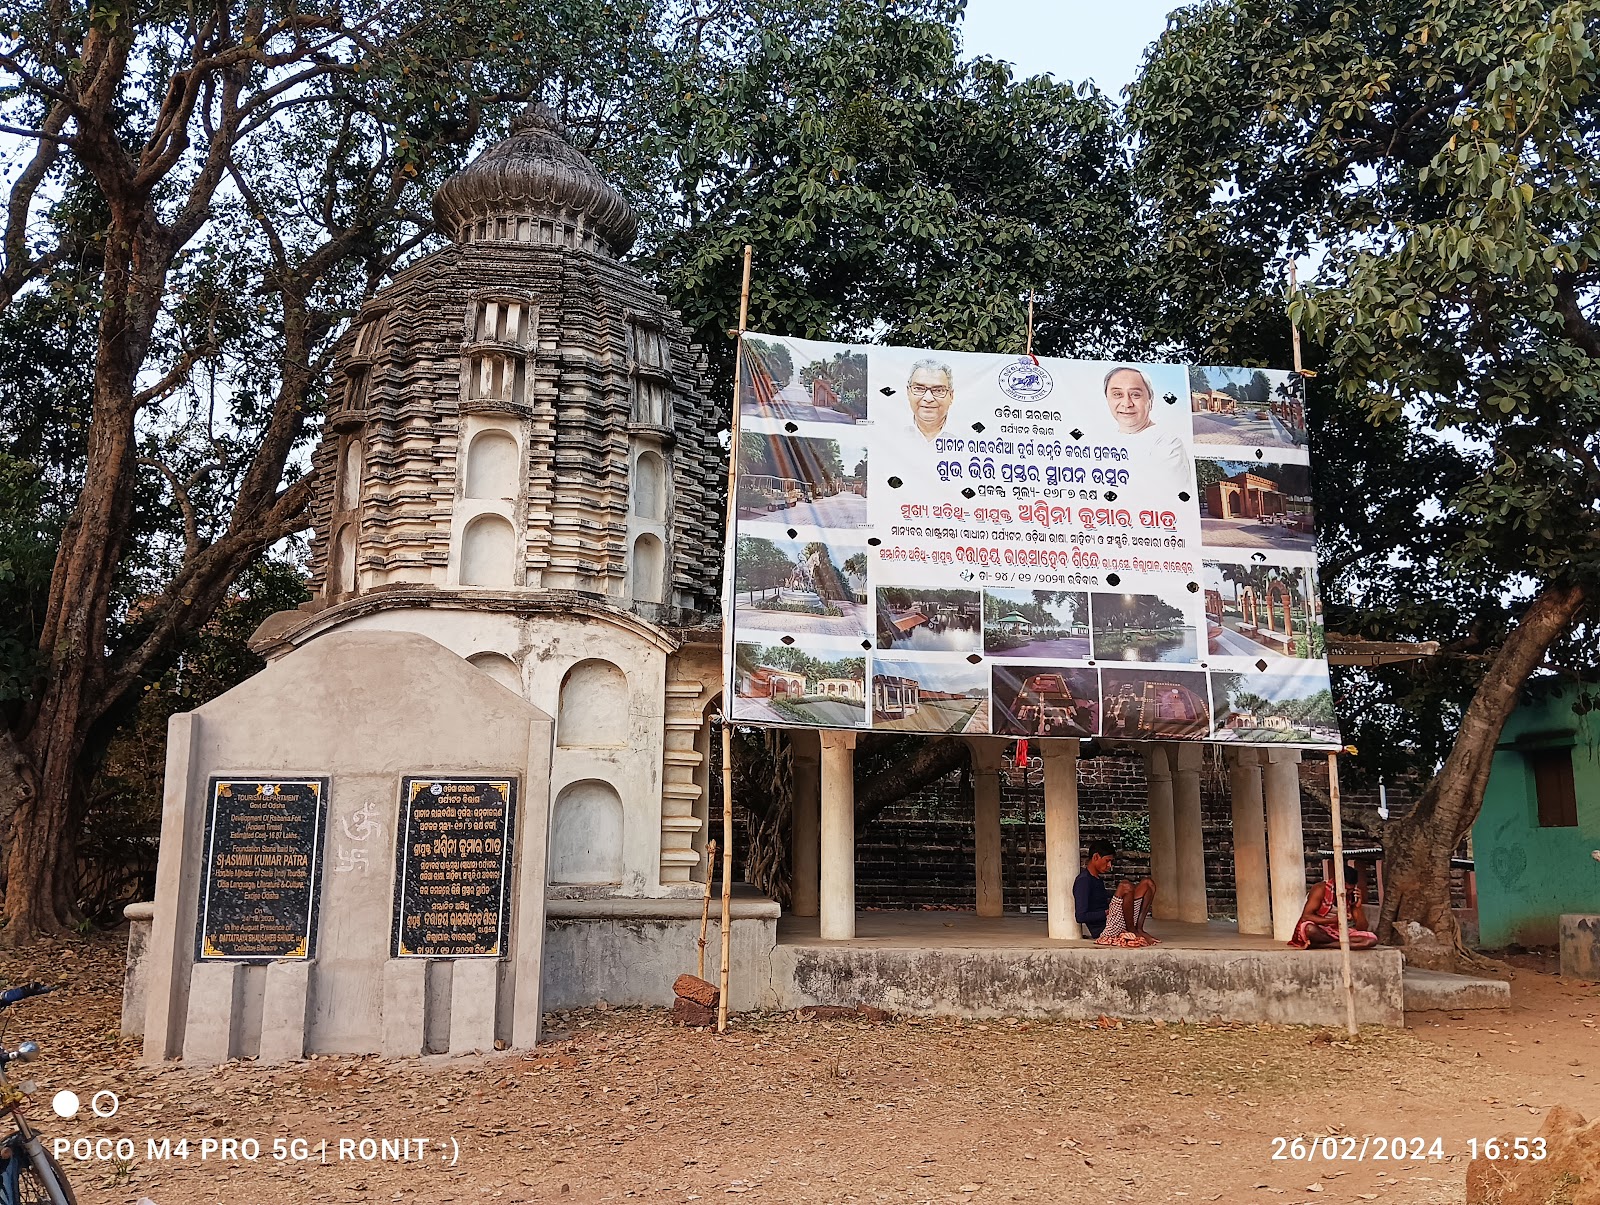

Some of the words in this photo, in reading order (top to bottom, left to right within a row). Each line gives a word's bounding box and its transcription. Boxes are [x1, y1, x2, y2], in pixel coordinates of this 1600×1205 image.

[1026, 410, 1062, 421] ସରକାର
[1001, 423, 1030, 434] ପର୍ଯ୍ୟଟନ
[1032, 425, 1054, 435] ବିଭାଗ
[936, 438, 964, 453] ପ୍ରାଚୀନ
[968, 437, 1014, 454] ରାଇବଣିଆ
[1018, 439, 1034, 459] ଦୁର୍ଗ
[1037, 440, 1061, 460] ଉନ୍ନତି
[1065, 445, 1090, 459] କରଣ
[1094, 446, 1129, 461] ପ୍ରକଳ୍ପର
[937, 460, 963, 481] ଶୁଭ
[969, 457, 995, 479] ଭିତ୍ତି
[1001, 464, 1040, 482] ପ୍ରସ୍ତର
[1046, 466, 1086, 485] ସ୍ଥାପନ
[1092, 468, 1129, 487] ଉତ୍ସବ
[978, 485, 1005, 497] ପ୍ରକଳ୍ପ
[1044, 488, 1075, 498] ୧୬୮୭
[1079, 490, 1097, 500] ଲକ୍ଷ
[901, 504, 929, 520] ମୁଖ୍ୟ
[974, 508, 1013, 525] ଶ୍ରୀଯୁକ୍ତ
[1078, 508, 1133, 530] କୁମାର
[1139, 510, 1177, 532] ପାତ୍ର
[891, 526, 922, 537] ମାନ୍ୟବର
[1098, 536, 1104, 544] ଓ
[1004, 549, 1068, 570] ଭାଉସାହେବ
[995, 572, 1008, 580] ୨୪
[1068, 572, 1098, 586] ରବିବାର
[462, 794, 480, 804] ବିଭାଗ
[460, 838, 482, 857] କୁମାର
[485, 838, 501, 855] ପାତ୍ର
[225, 855, 253, 865] ASWINI
[254, 855, 281, 866] KUMAR
[284, 855, 308, 866] PATRA
